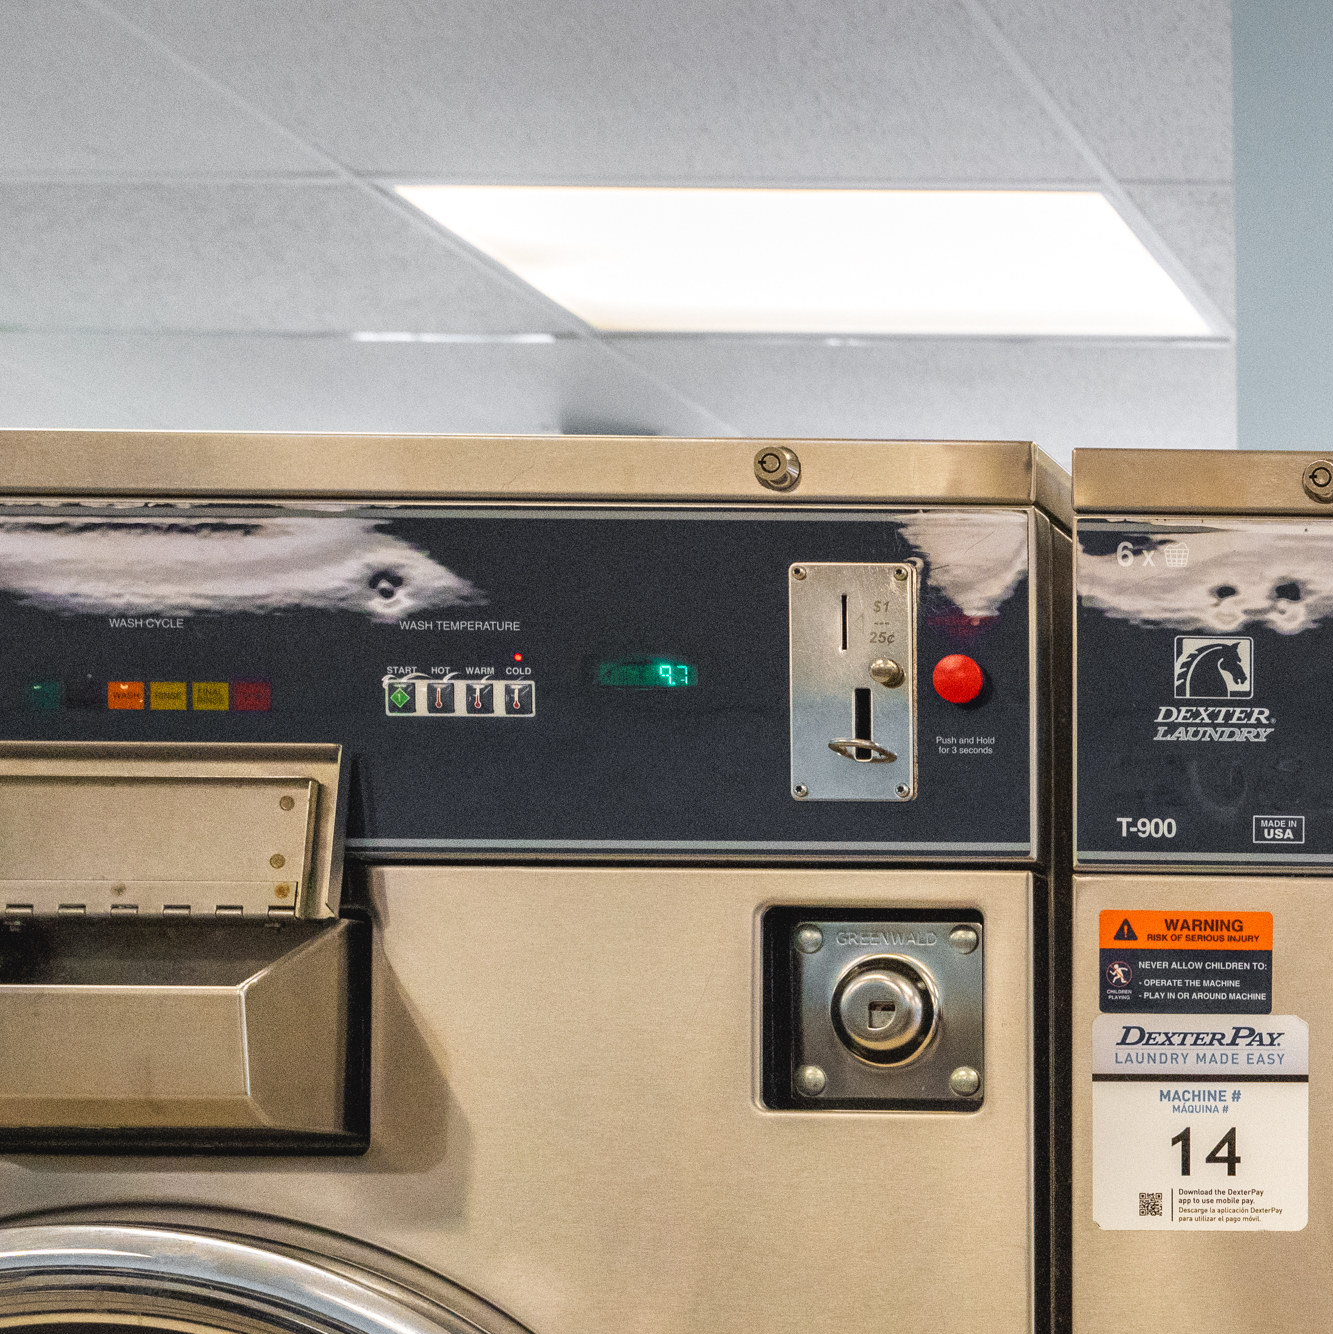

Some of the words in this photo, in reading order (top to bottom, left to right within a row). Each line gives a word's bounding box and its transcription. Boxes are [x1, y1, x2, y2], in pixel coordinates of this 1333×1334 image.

[873, 600, 890, 613] $1
[109, 618, 143, 628] WASH
[145, 618, 184, 628] CYCLE
[399, 620, 433, 631] WASH
[436, 621, 520, 631] TEMPERATURE
[386, 666, 418, 674] START
[431, 666, 451, 674] HOT
[465, 667, 495, 675] WARM
[505, 667, 532, 675] COLD
[1153, 706, 1270, 724] DEXTER
[1153, 726, 1275, 742] LAUNDRY
[936, 736, 956, 745] Push
[958, 736, 974, 745] and
[975, 736, 995, 745] Hold
[938, 746, 949, 754] for
[951, 746, 957, 754] 3
[958, 746, 993, 754] seconds
[1116, 818, 1177, 838] T-900
[1260, 820, 1285, 828] MADE
[1287, 820, 1297, 828] IN
[1263, 828, 1294, 840] USA
[1164, 918, 1243, 932] WARNING
[836, 932, 938, 946] GREENWALD
[1146, 934, 1167, 942] RISK
[1169, 934, 1182, 942] OF
[1184, 934, 1225, 943] SERIOUS
[1226, 935, 1260, 943] INJURY
[1138, 961, 1168, 970] NEVER
[1170, 961, 1202, 970] ALLOW
[1204, 962, 1250, 970] CHILDREN
[1252, 962, 1268, 970] TO:
[1143, 979, 1182, 988] OPERATE
[1185, 979, 1200, 988] THE
[1202, 979, 1240, 988] MACHINE
[1143, 992, 1164, 1000] PLAY
[1166, 992, 1175, 1000] IN
[1176, 992, 1189, 1000] OR
[1191, 992, 1227, 1000] AROUND
[1228, 992, 1267, 1001] MACHINE
[1115, 1052, 1189, 1064] LAUNDRY
[1195, 1053, 1239, 1065] MADE
[1244, 1053, 1285, 1065] EASY
[1159, 1090, 1226, 1102] MACHINE
[1231, 1090, 1242, 1102] #
[1172, 1103, 1219, 1114] MÁQUINA
[1221, 1104, 1229, 1114] #
[1171, 1126, 1242, 1177] 14
[1227, 1189, 1264, 1197] DexterPay
